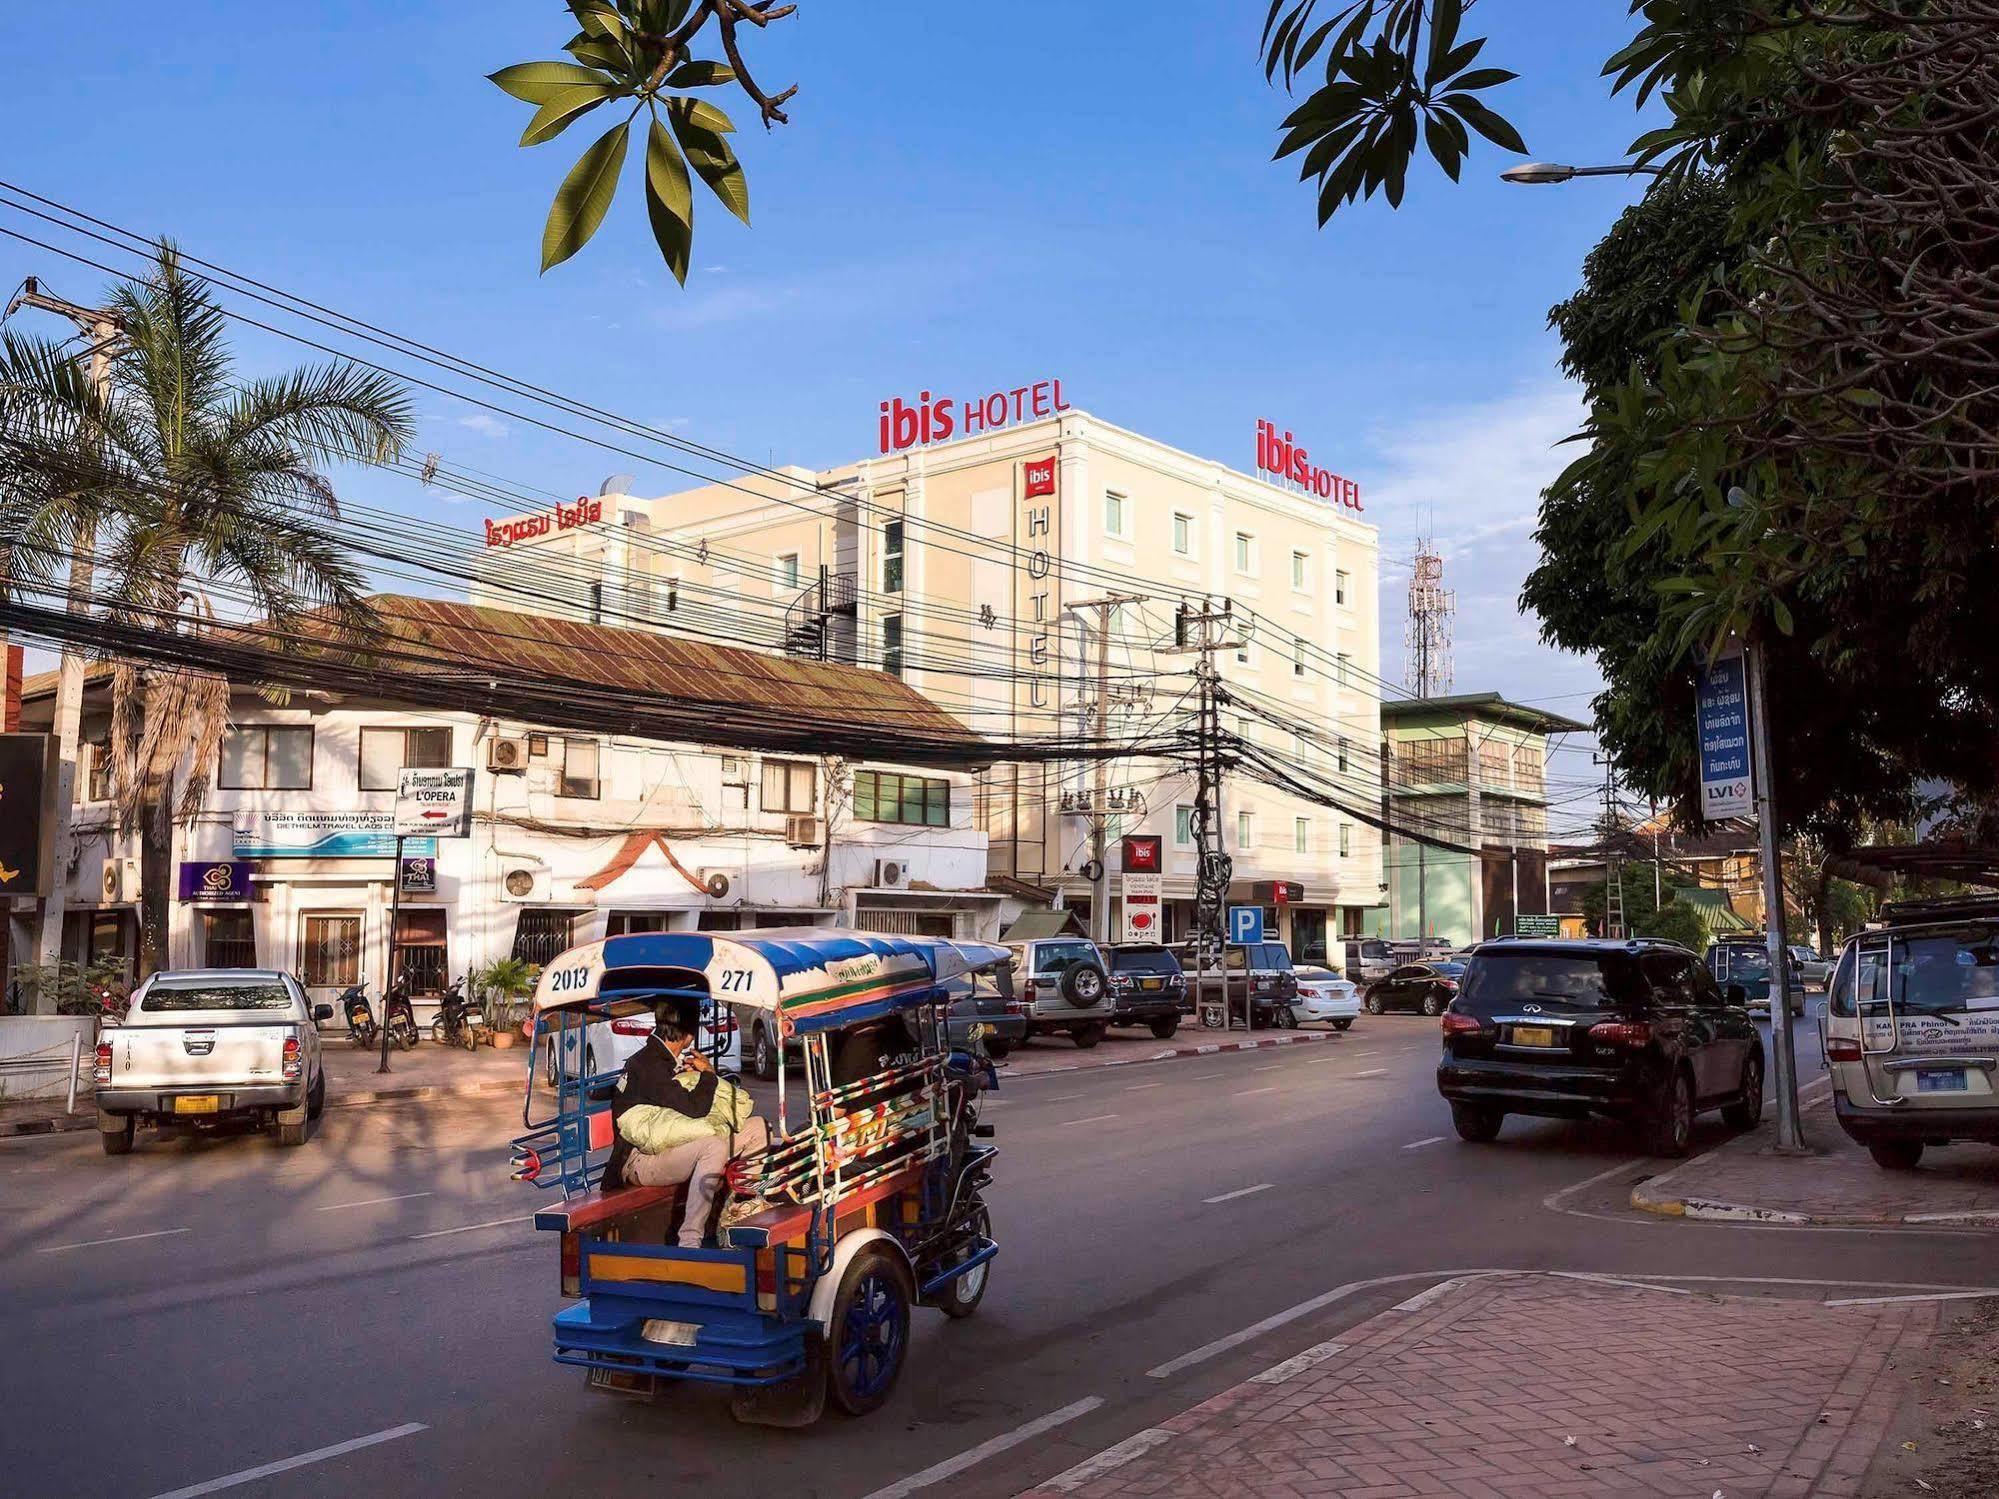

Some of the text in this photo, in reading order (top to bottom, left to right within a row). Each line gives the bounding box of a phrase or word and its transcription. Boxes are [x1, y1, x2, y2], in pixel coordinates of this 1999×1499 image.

[880, 379, 1071, 454] ibis HOTEL
[1029, 468, 1050, 484] ibis
[1257, 418, 1364, 512] ibis HOTEL
[1028, 505, 1049, 709] HOTEL
[416, 791, 456, 801] L'OPERA
[1708, 785, 1733, 799] LVI
[1135, 848, 1150, 858] ibis
[1236, 909, 1255, 941] P
[552, 967, 588, 991] 2013
[721, 970, 754, 992] 271
